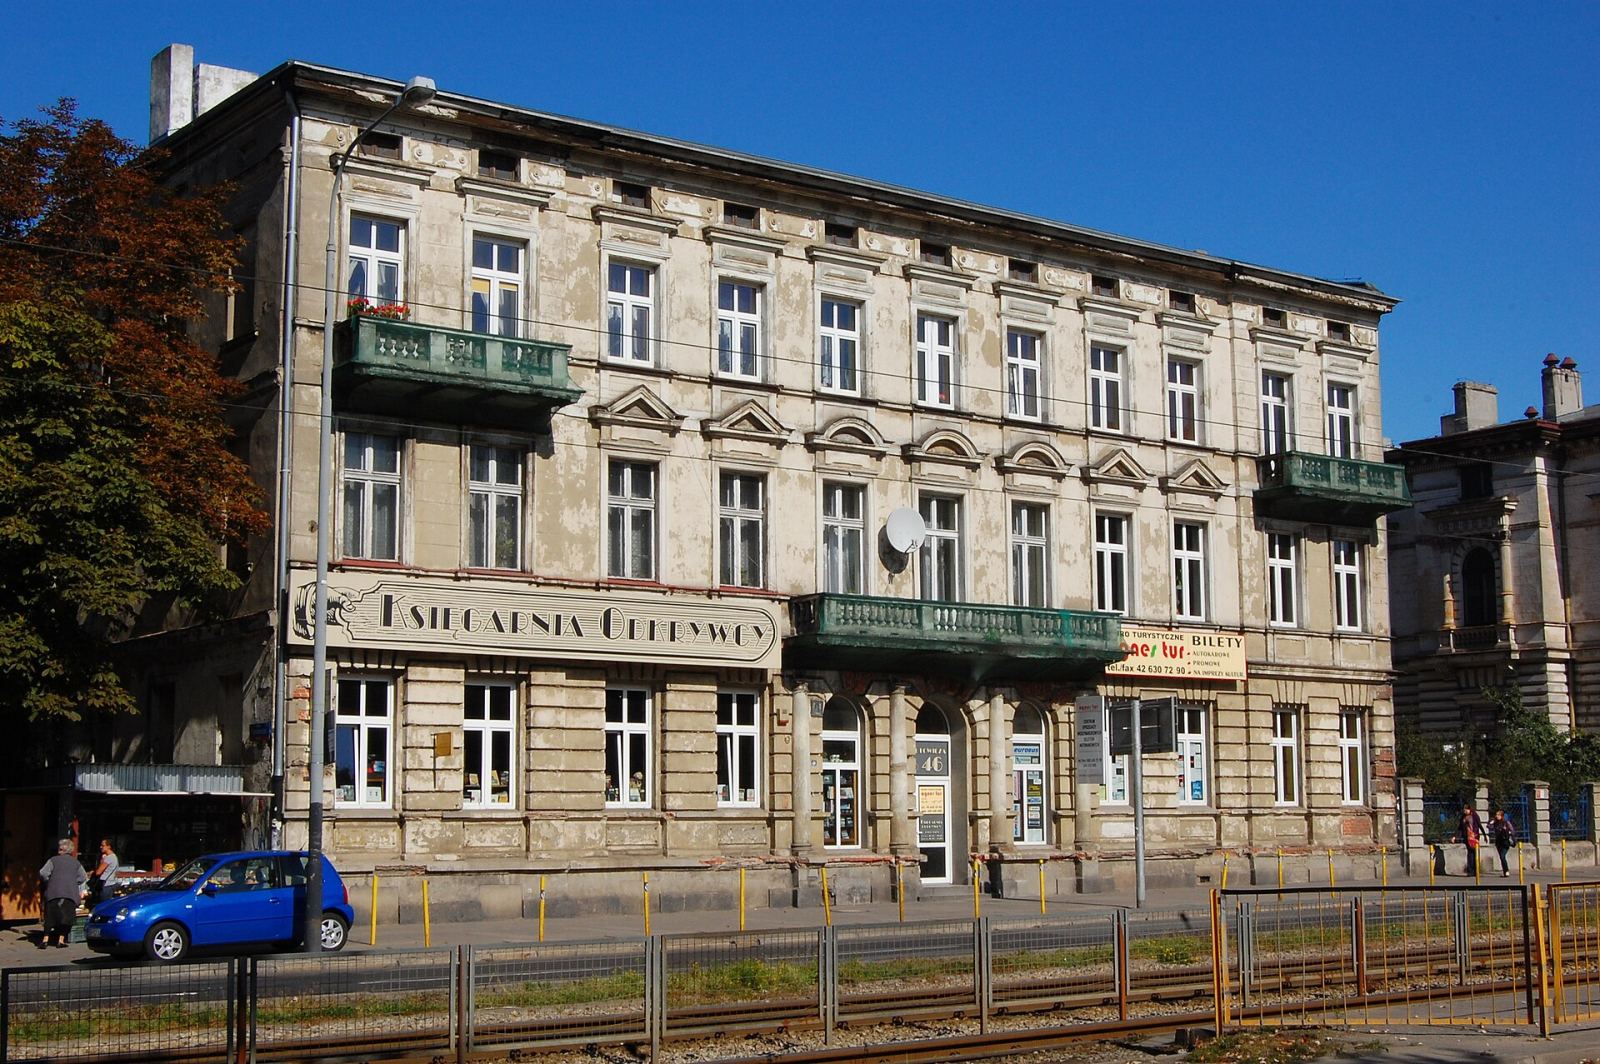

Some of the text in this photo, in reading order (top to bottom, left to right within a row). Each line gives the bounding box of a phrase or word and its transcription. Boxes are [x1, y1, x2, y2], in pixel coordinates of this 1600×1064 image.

[380, 593, 774, 647] KSIĘGARNIA ODKRYWCY
[1132, 631, 1185, 641] TURYSTYCZNE
[1192, 635, 1242, 648] BILETY
[1162, 641, 1184, 659] tur
[1136, 664, 1146, 673] 42
[1148, 665, 1162, 673] 630
[1164, 666, 1173, 674] 72
[1176, 666, 1186, 674] 90
[921, 756, 943, 772] 46
